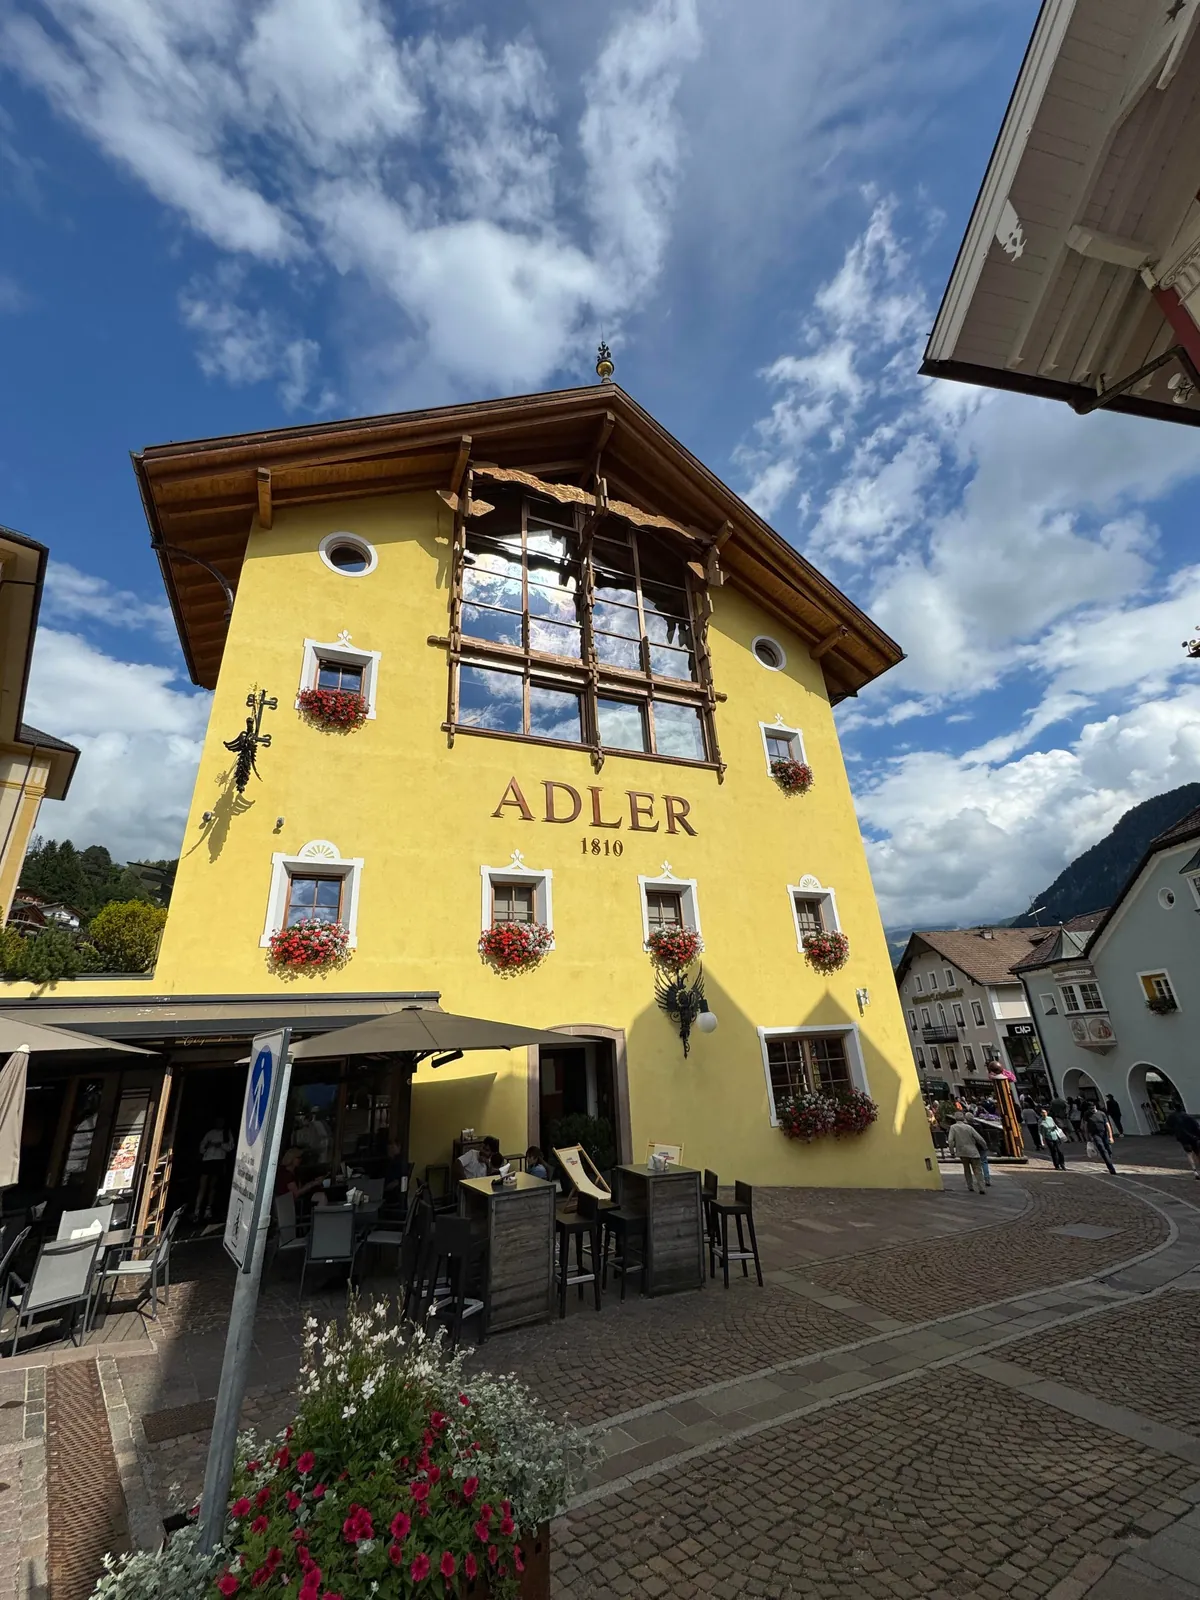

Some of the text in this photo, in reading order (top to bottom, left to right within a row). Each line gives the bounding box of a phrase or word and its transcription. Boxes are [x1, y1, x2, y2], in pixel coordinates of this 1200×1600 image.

[490, 775, 698, 837] ADLER
[580, 837, 624, 857] 1810
[1014, 1025, 1031, 1034] CMP
